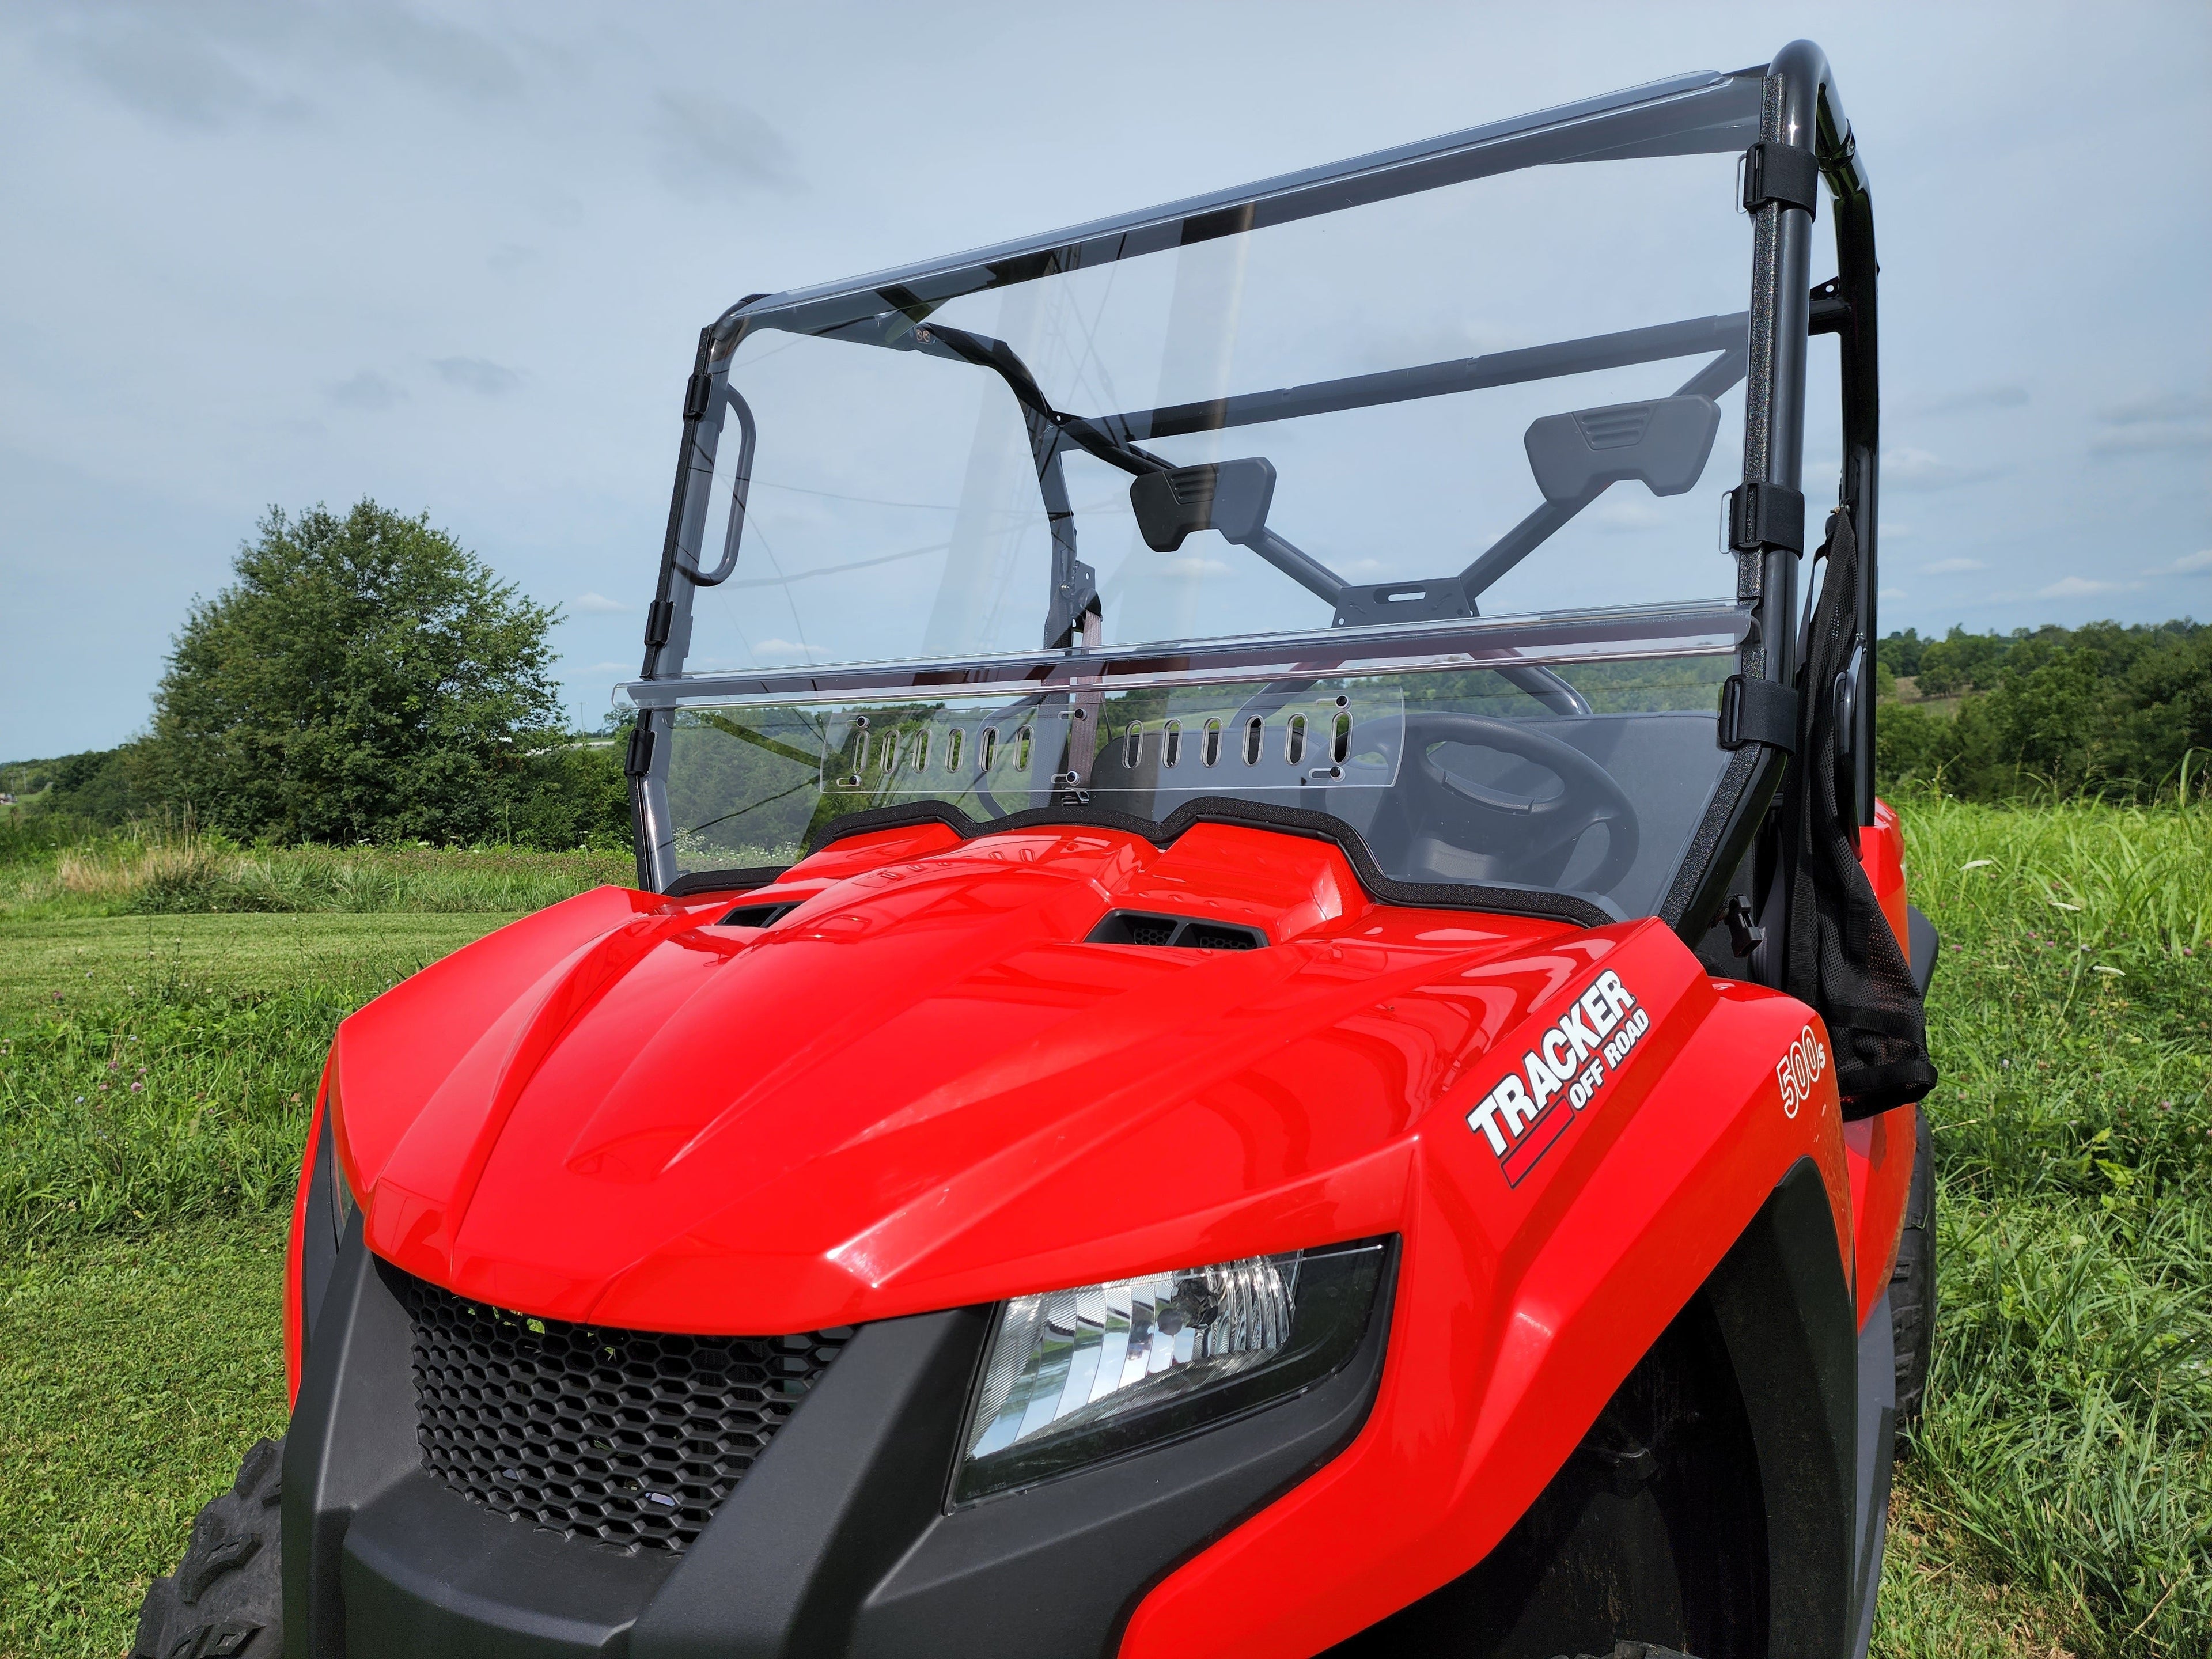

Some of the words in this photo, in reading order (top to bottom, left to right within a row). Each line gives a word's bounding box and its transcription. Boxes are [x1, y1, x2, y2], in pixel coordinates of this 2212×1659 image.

[1466, 969, 1635, 1158] TRACKER
[1569, 1058, 1605, 1110] OFF
[1603, 1008, 1650, 1070] ROAD
